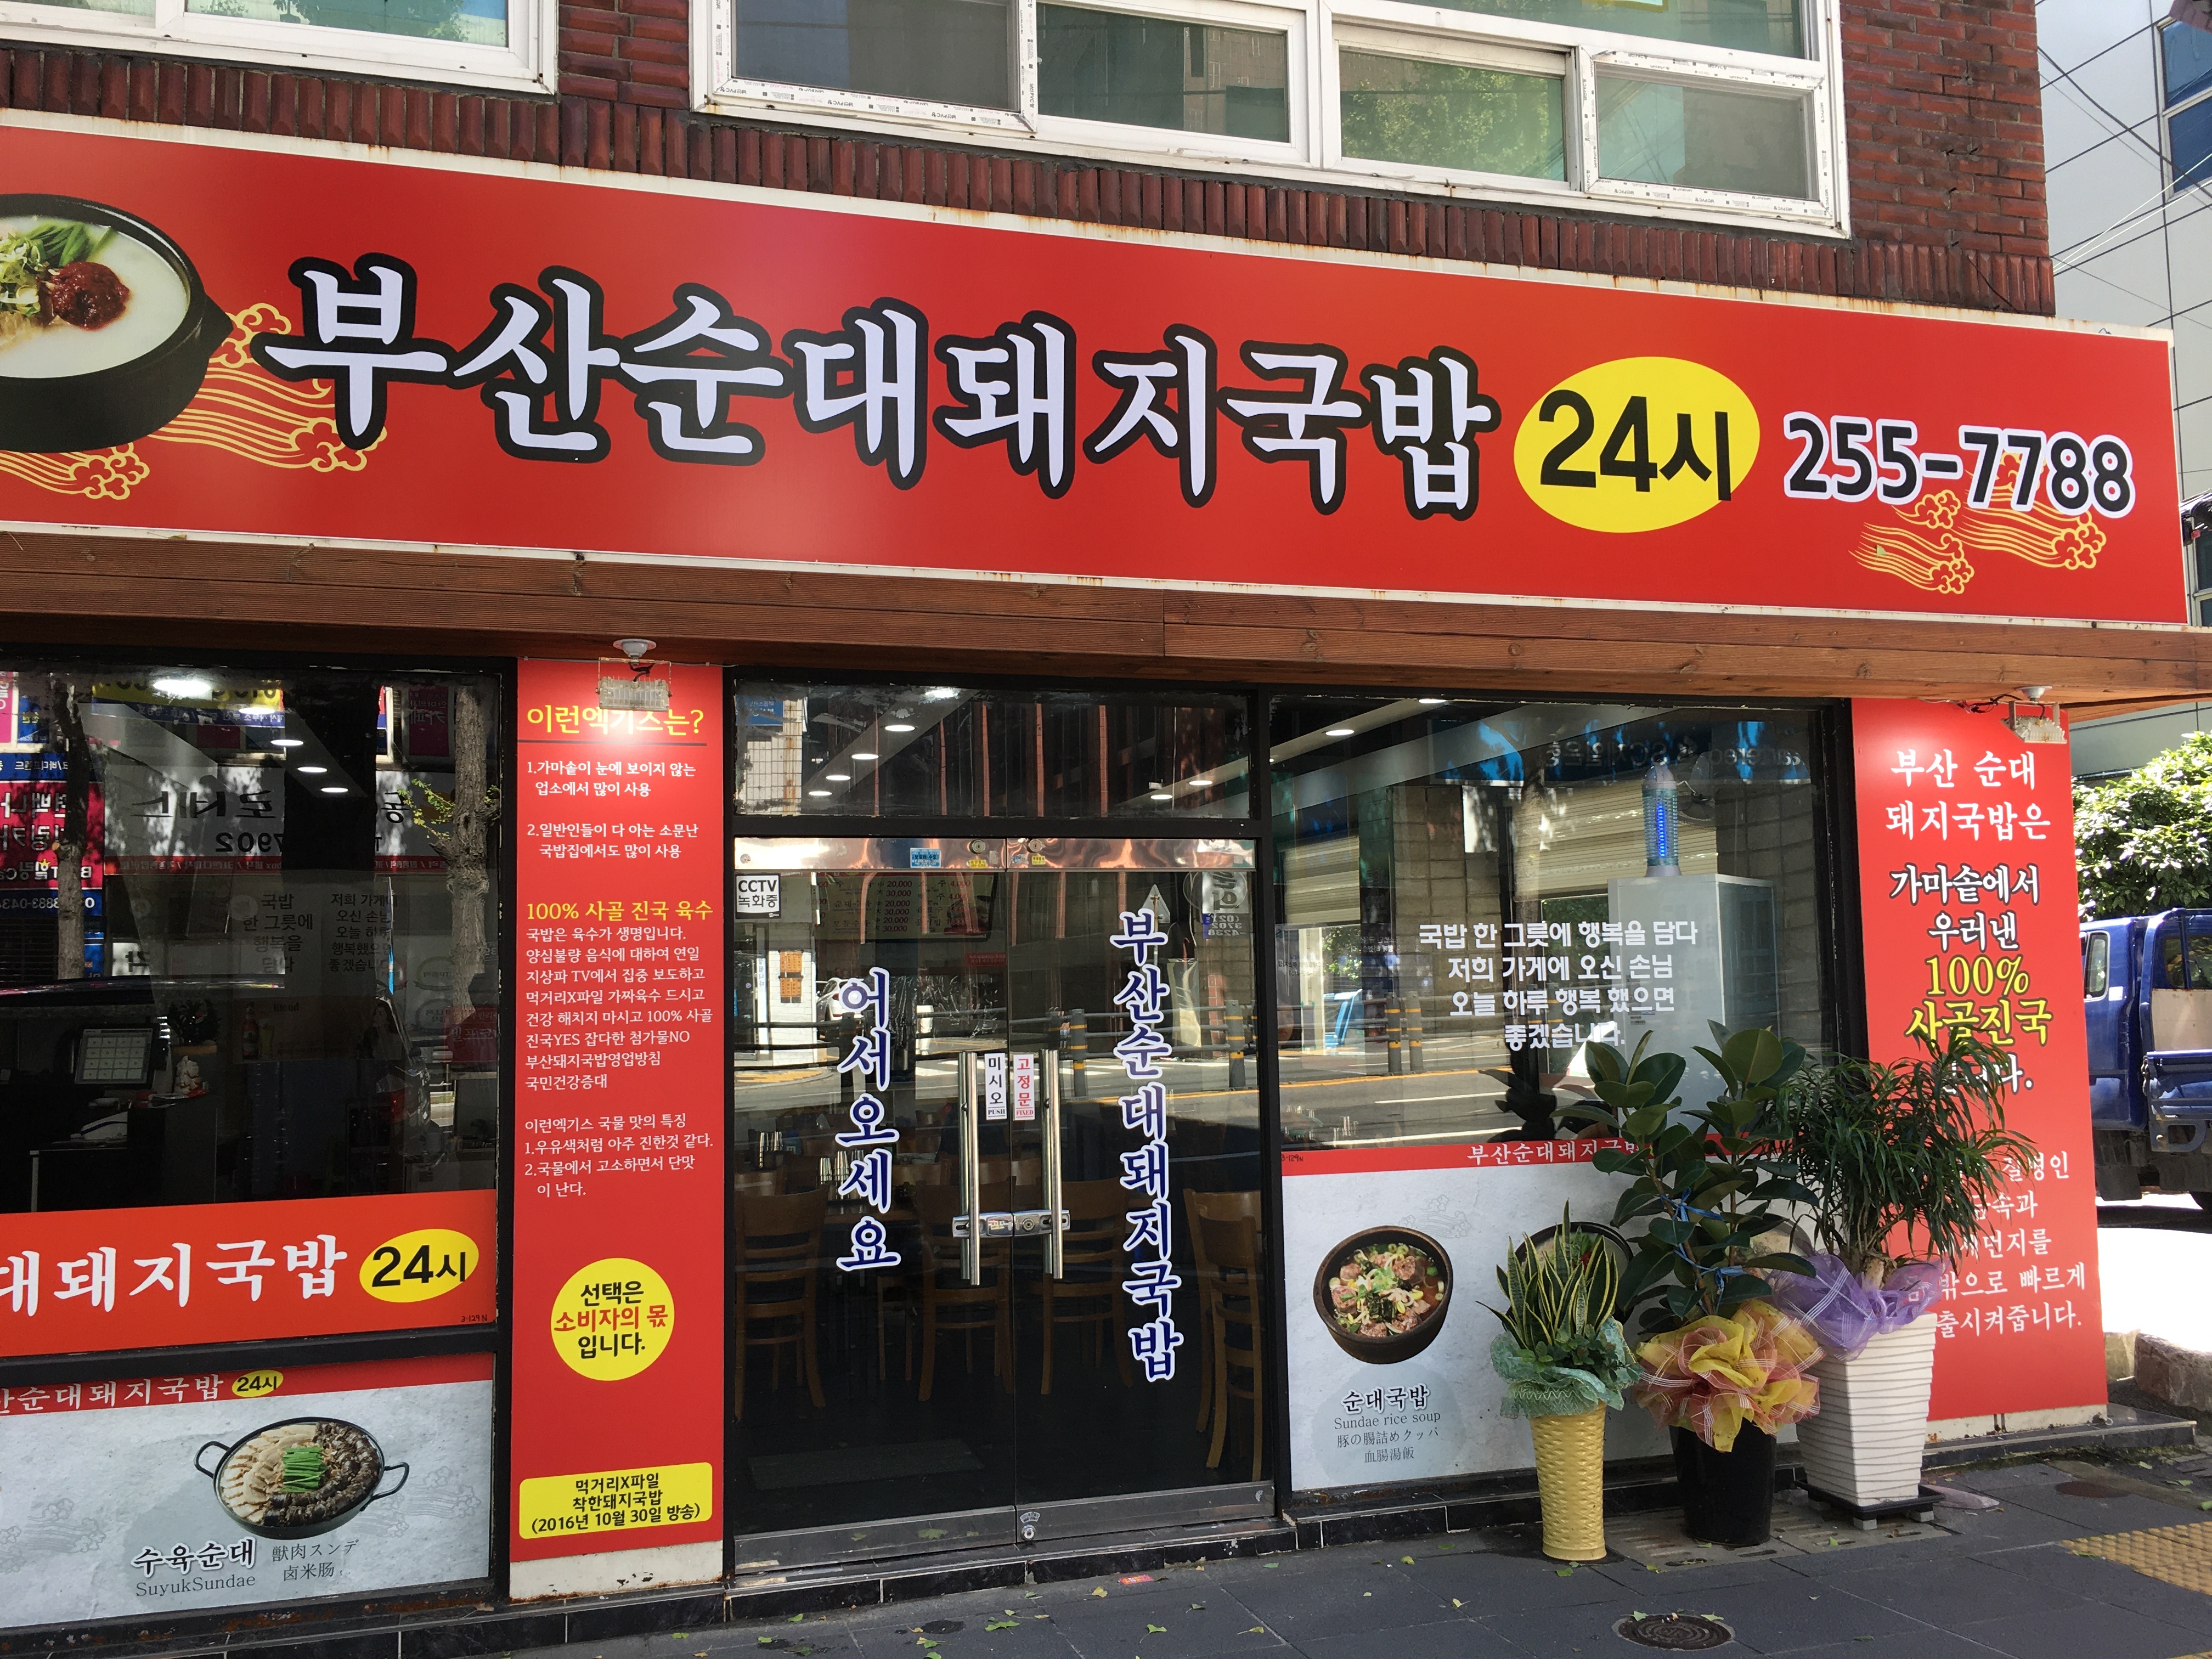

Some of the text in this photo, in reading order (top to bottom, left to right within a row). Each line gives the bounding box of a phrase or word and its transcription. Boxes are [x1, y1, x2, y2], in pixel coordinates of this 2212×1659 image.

[250, 252, 2135, 520] 부산순대돼지국밥 24시 255-7788
[527, 704, 704, 736] 이런엑기스는?
[527, 761, 696, 777] 1.가마솥이 눈에 보이지 않는
[1891, 749, 2036, 790] 부산 순대
[535, 782, 651, 797] 업소에서 많이 사용
[527, 823, 698, 838] 2.일반인들이 다 아는 소문난
[1886, 799, 2051, 841] 돼지국밥은
[539, 844, 681, 858] 국밥집에서도 많이 사용
[738, 879, 777, 892] CCTV
[1889, 863, 2040, 905] 가마솥에서
[262, 894, 294, 910] 국밥
[331, 894, 356, 906] 저희
[527, 900, 713, 922] 100% 사골 진국 육수
[738, 894, 777, 908] 녹화중
[243, 914, 313, 932] 한 그릇에
[336, 910, 361, 922] 오신
[336, 927, 361, 939] 오늘
[526, 926, 686, 943] 국밥은 육수가 생명입니다.
[1419, 924, 1468, 949] 국밥
[1474, 923, 1497, 948] 한
[1504, 922, 1571, 947] 그릇에
[1578, 920, 1645, 948] 행복을
[1654, 921, 1698, 945] 담다
[1928, 911, 2019, 952] 우러낸
[253, 935, 303, 952] 행복을
[526, 946, 699, 963] 양심불량 음식에 대하여 연일
[526, 967, 706, 984] 지상파 TV에서 집중 보도하고
[1448, 955, 1672, 982] 저희 가게에 오신 손님
[1926, 954, 2029, 997] 100%
[526, 988, 705, 1005] 먹거리X파일 가짜육수 드시고
[1450, 988, 1674, 1016] 오늘 하루 행복 했으면
[526, 1009, 713, 1027] 건강 해치지 마시고 100% 사골
[1904, 998, 2053, 1047] 사골진국
[526, 1030, 690, 1048] 진국YES 잡다한 첨가물NO
[1505, 1022, 1624, 1051] 좋겠습니다.
[526, 1051, 661, 1070] 부산돼지국밥영업방침
[526, 1074, 607, 1091] 국민건강증대
[988, 1057, 1003, 1104] 미시오
[1017, 1058, 1031, 1107] 고정문
[525, 1113, 686, 1133] 이런엑기스 국물 맛의 특징
[838, 967, 900, 1271] 어서오세요
[525, 1133, 713, 1155] 1.우유색처럼 아주 진한것 같다.
[1110, 908, 1183, 1382] 부산순대돼지국밥
[525, 1155, 695, 1176] 2.국물에서 고소하면서 단맛
[537, 1181, 586, 1198] 이 난다.
[1937, 1228, 2052, 1260] 세먼지를
[371, 1244, 467, 1288] 24시
[1939, 1261, 2085, 1301] 밖으로 빠르게
[580, 1280, 644, 1307] 선택은
[554, 1308, 639, 1333] 소비자의
[578, 1333, 645, 1359] 입니다.
[236, 1373, 278, 1392] 24시
[1340, 1383, 1431, 1414] 순대국밥
[1334, 1412, 1441, 1430] Sundae rice soup
[575, 1472, 659, 1494] 먹거리X파일
[573, 1489, 663, 1513] 착한돼지국밥
[532, 1502, 701, 1534] (2016년 10월 30일 방송)
[132, 1537, 256, 1577] 수육순대
[136, 1574, 256, 1597] SuyukSundae
